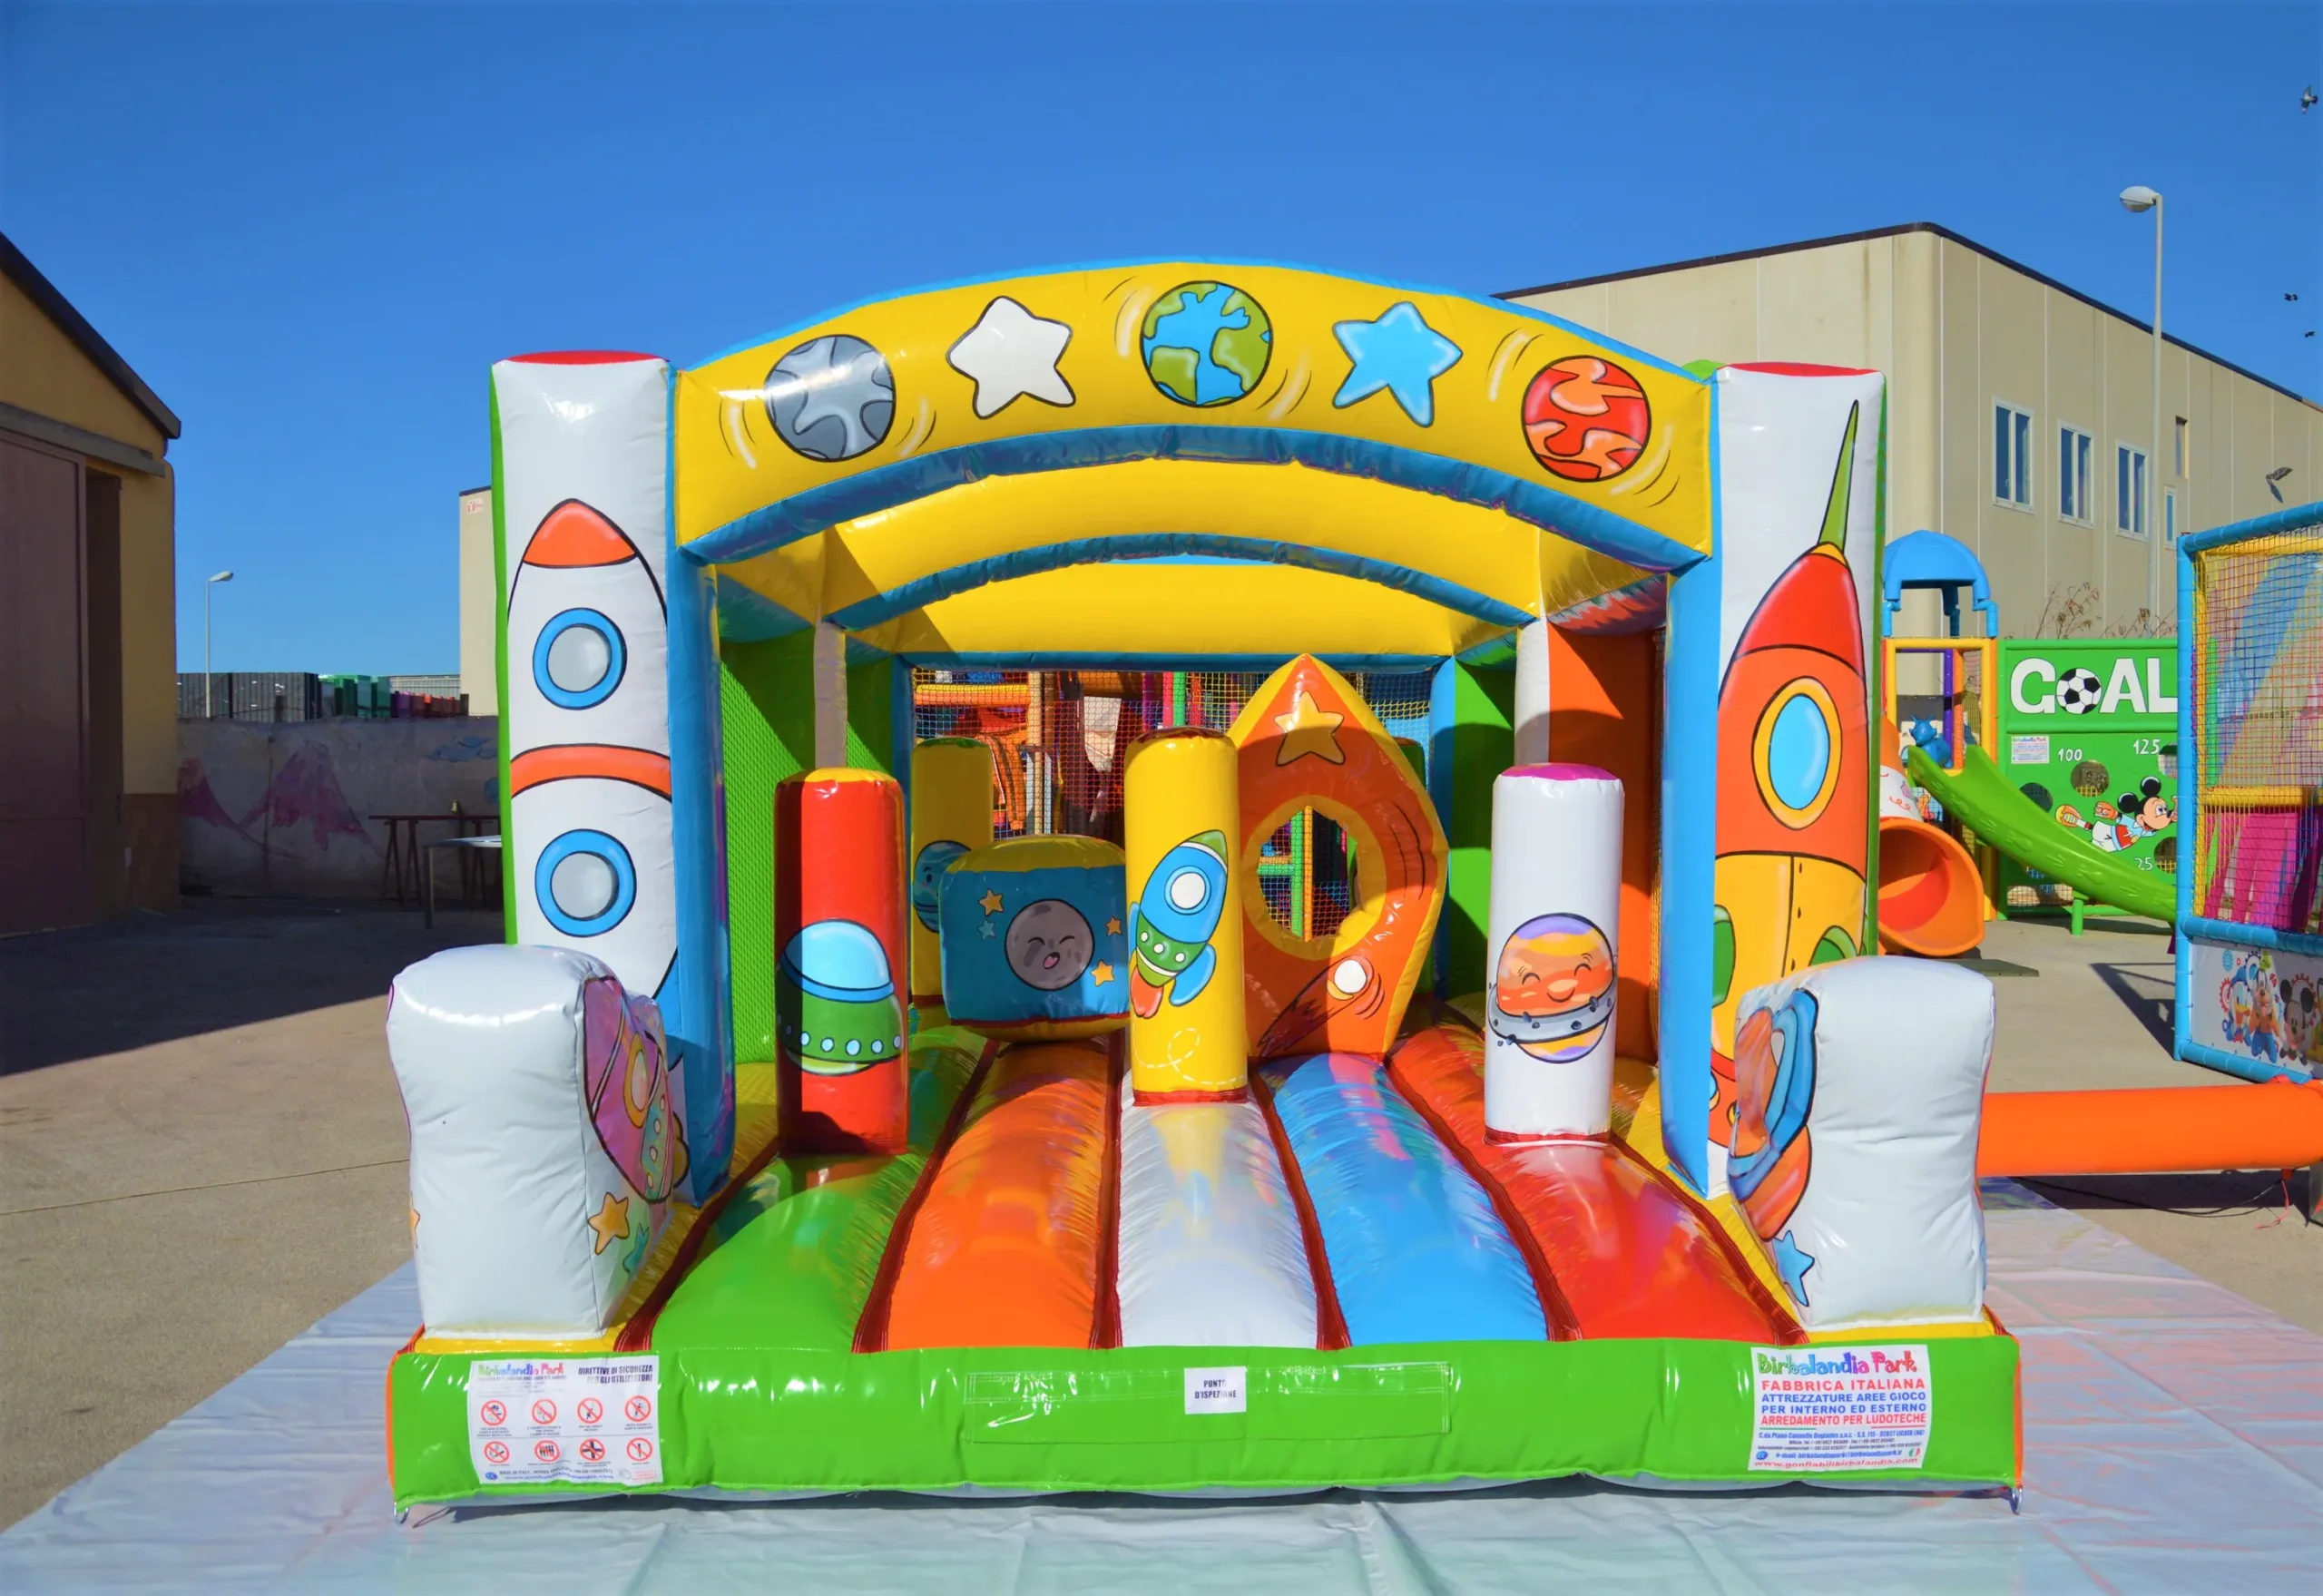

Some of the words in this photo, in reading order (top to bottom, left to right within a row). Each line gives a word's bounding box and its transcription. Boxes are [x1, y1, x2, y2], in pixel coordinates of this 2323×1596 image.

[2010, 657, 2178, 715] GOAL
[2133, 739, 2161, 755] 125
[2057, 748, 2083, 762] 100
[2134, 857, 2153, 871] 25
[1757, 1352, 1869, 1376] Birbalandia
[1870, 1350, 1917, 1373] Park
[578, 1366, 610, 1375] DIRETTIVE
[611, 1366, 617, 1375] DI
[619, 1365, 652, 1374] SICUREZZA
[600, 1376, 610, 1384] GLI
[1761, 1379, 1844, 1391] FABBRICA
[1851, 1378, 1925, 1390] ITALIANA
[1761, 1393, 1853, 1403] ATTREZZATURE
[1857, 1393, 1887, 1402] AREE
[1889, 1392, 1926, 1401] GIOCO
[1761, 1405, 1786, 1414] PER
[1790, 1405, 1846, 1414] INTERNO
[1850, 1405, 1866, 1413] ED
[1870, 1403, 1926, 1412] ESTERNO
[1761, 1415, 1839, 1425] ARREDAMENTO
[1843, 1415, 1863, 1425] PER
[1866, 1413, 1926, 1424] LUDOTECHE
